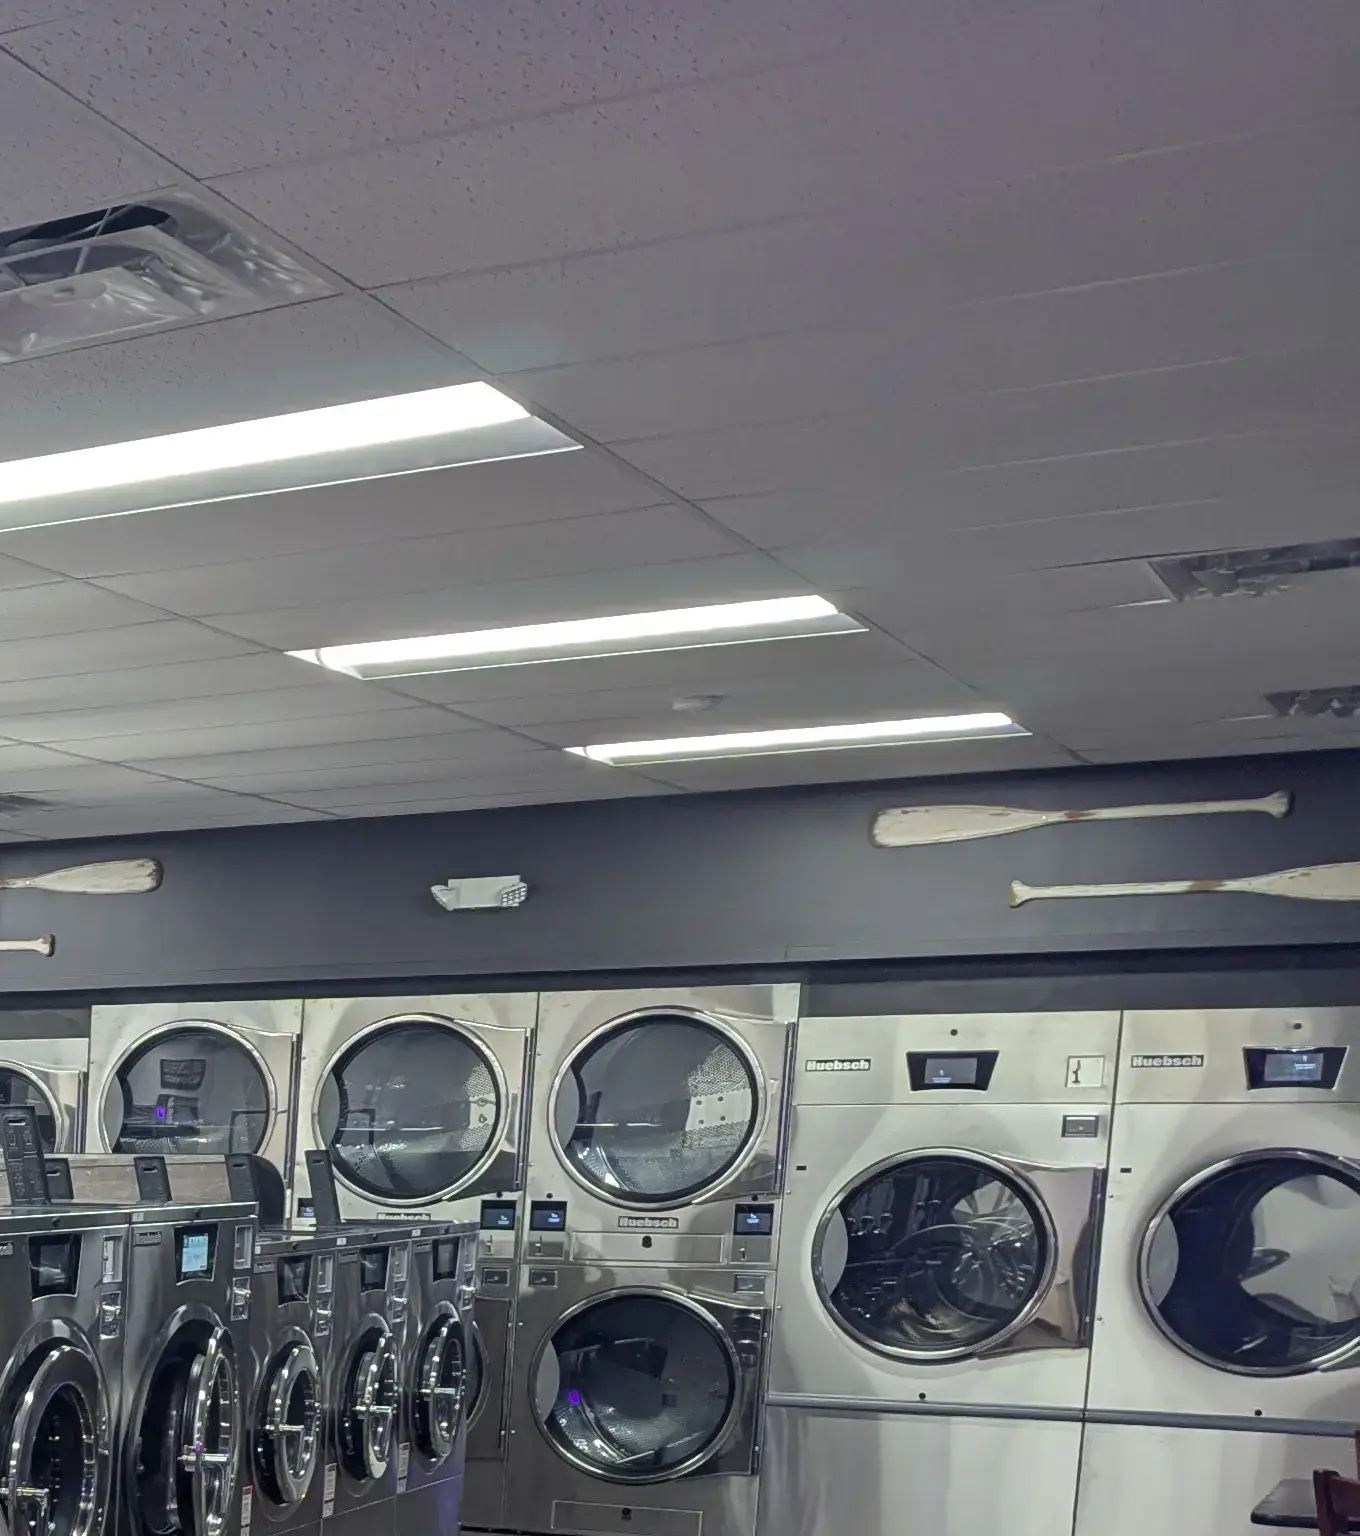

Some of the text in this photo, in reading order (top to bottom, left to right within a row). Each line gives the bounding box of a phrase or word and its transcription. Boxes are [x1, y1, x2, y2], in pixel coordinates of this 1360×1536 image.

[806, 1060, 870, 1070] Huebsch
[1132, 1056, 1202, 1067] Huebsch
[619, 1217, 678, 1228] Huebsch
